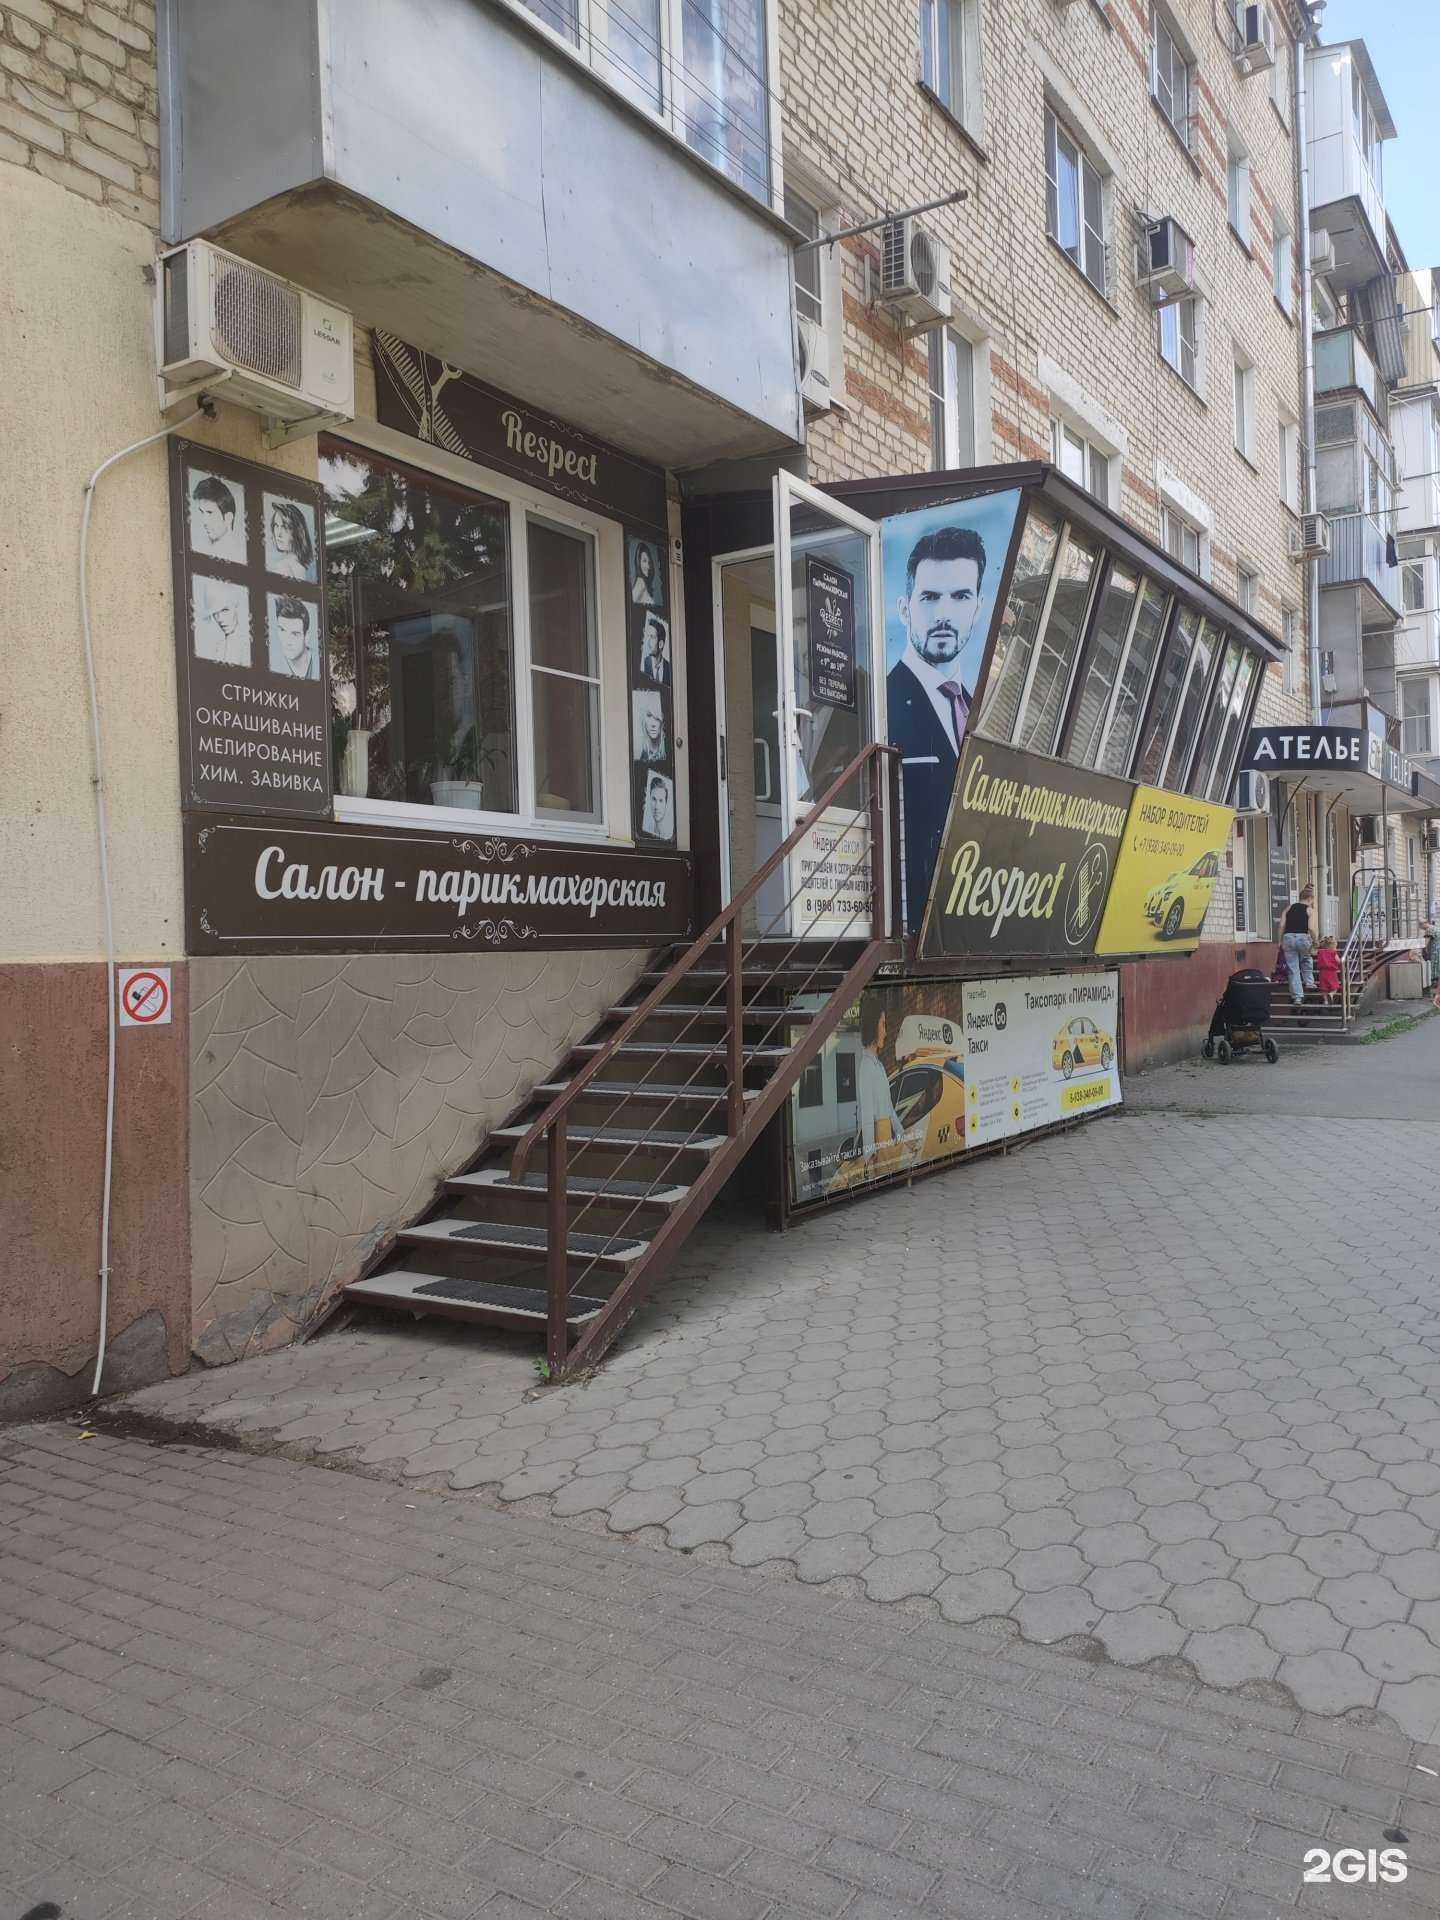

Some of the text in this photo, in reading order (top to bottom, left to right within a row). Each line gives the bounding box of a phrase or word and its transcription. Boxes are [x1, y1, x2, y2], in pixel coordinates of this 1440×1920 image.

[502, 411, 598, 485] Respect
[222, 683, 299, 712] СТРИЖКИ
[196, 707, 323, 741] ОКРАШИВАНИЕ
[199, 736, 323, 767] МЕЛИРОВАНИЕ
[1253, 736, 1360, 761] АТЕЛЬЕ
[199, 763, 323, 793] ХИМ. ЗАВИВКА
[1139, 803, 1209, 834] НАБОР ВОДИТЕЛЕЙ
[254, 846, 384, 901] Салон
[415, 868, 667, 918] парикмахерская
[945, 841, 1066, 938] Respect
[806, 899, 812, 912] 8
[1025, 985, 1114, 1010] Таксопарк «ПИРАМИДА»
[919, 1023, 942, 1043] Яндекс
[967, 1011, 993, 1031] Яндекс
[967, 1037, 989, 1054] Такси
